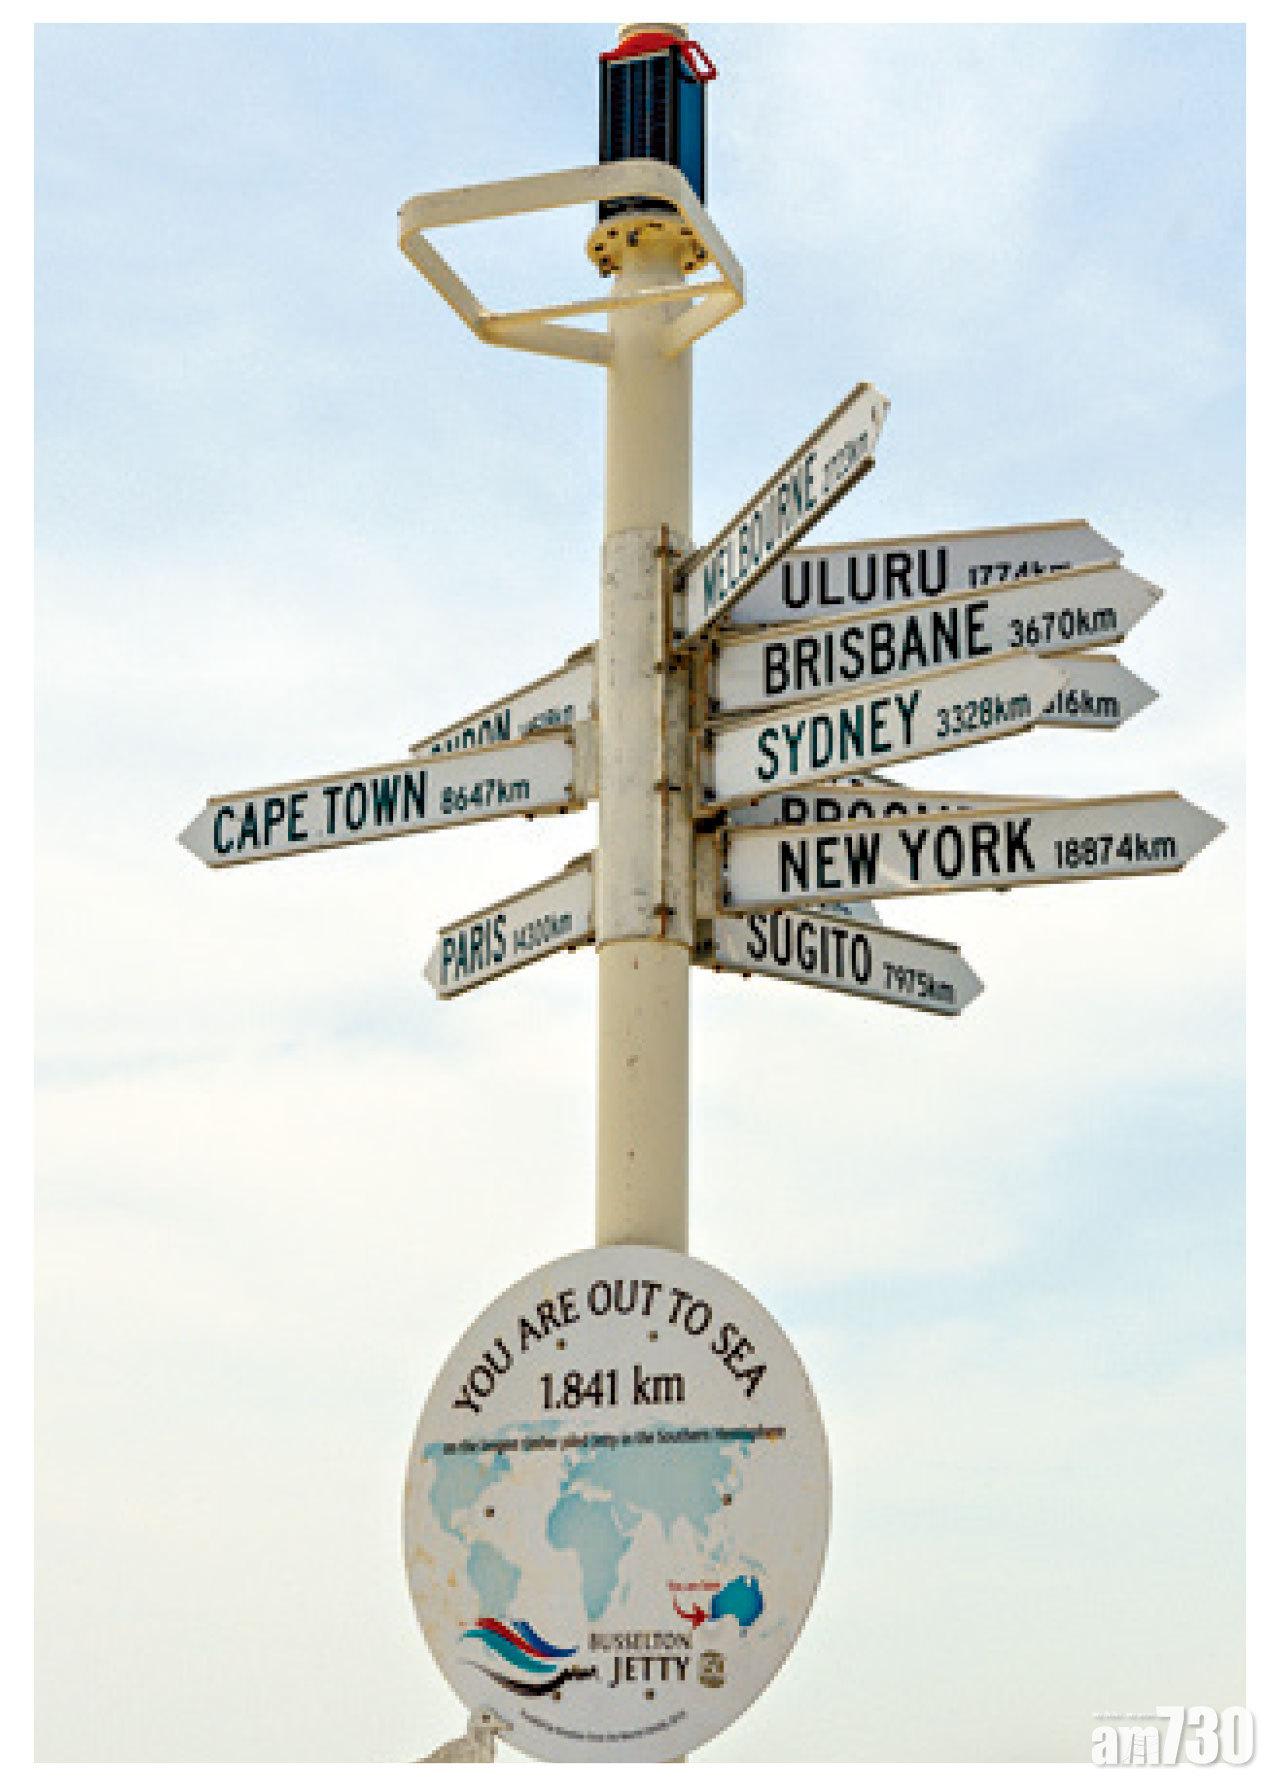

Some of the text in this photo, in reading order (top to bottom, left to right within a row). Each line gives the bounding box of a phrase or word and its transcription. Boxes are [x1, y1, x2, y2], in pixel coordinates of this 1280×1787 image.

[703, 452, 818, 616] MELBOURNE
[781, 546, 948, 609] ULURU
[762, 600, 1118, 696] BRISBANE 3670km
[757, 689, 1033, 782] SYDNEY 3328km
[1042, 689, 1121, 719] 16km
[212, 770, 531, 855] CAPE TOWN 8647km
[780, 832, 881, 893] NEW
[898, 817, 1037, 882] YORK
[439, 914, 507, 985] PARIS
[746, 913, 873, 985] SUGITO
[451, 1279, 768, 1415] YOU ARE OUT TO SEA
[540, 1362, 686, 1410] 1.841 km
[606, 1656, 691, 1689] JETTY
